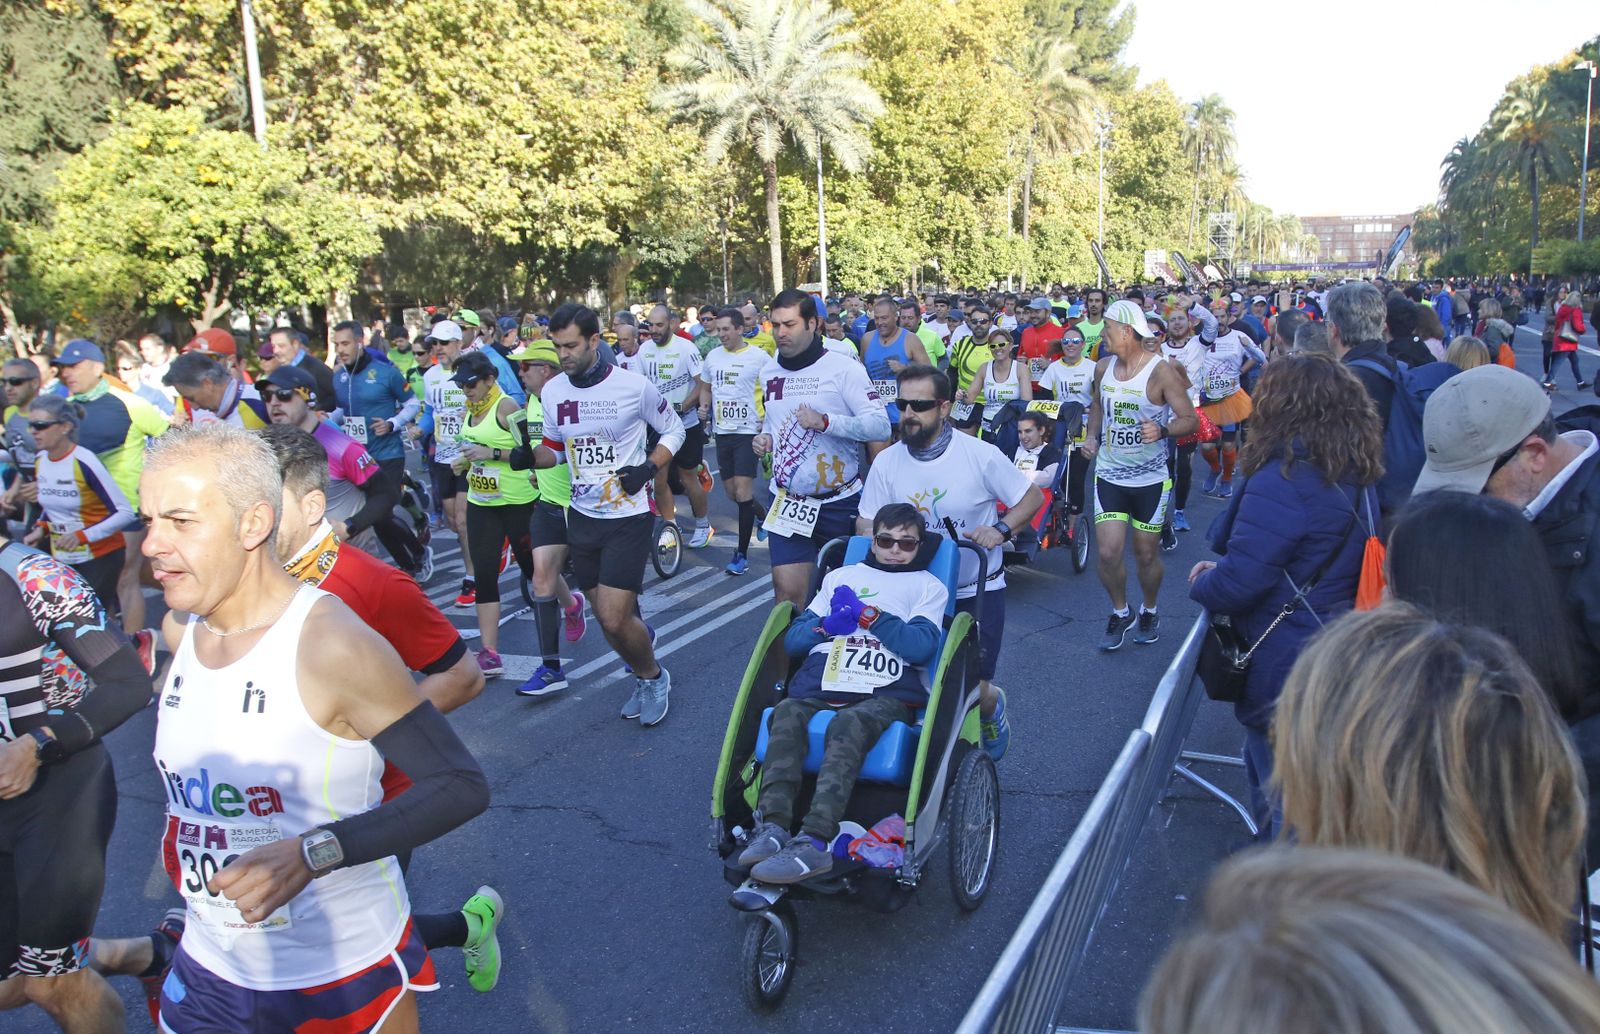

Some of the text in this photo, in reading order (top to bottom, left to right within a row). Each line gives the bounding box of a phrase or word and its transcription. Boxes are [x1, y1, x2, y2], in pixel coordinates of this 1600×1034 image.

[1209, 379, 1231, 390] 6595
[590, 400, 618, 408] MEDIA
[1113, 401, 1140, 411] CARROS
[579, 407, 618, 415] MARATÓN
[722, 407, 748, 418] 6019
[1113, 416, 1136, 425] FUEGO
[440, 423, 465, 435] 763
[1111, 430, 1144, 446] 7566
[576, 445, 616, 466] 7354
[470, 474, 498, 490] 6599
[781, 499, 818, 525] 7355
[844, 648, 900, 677] 7400
[159, 759, 285, 818] indea
[231, 827, 279, 836] 35 MEDIA
[231, 834, 281, 843] MARATÓN
